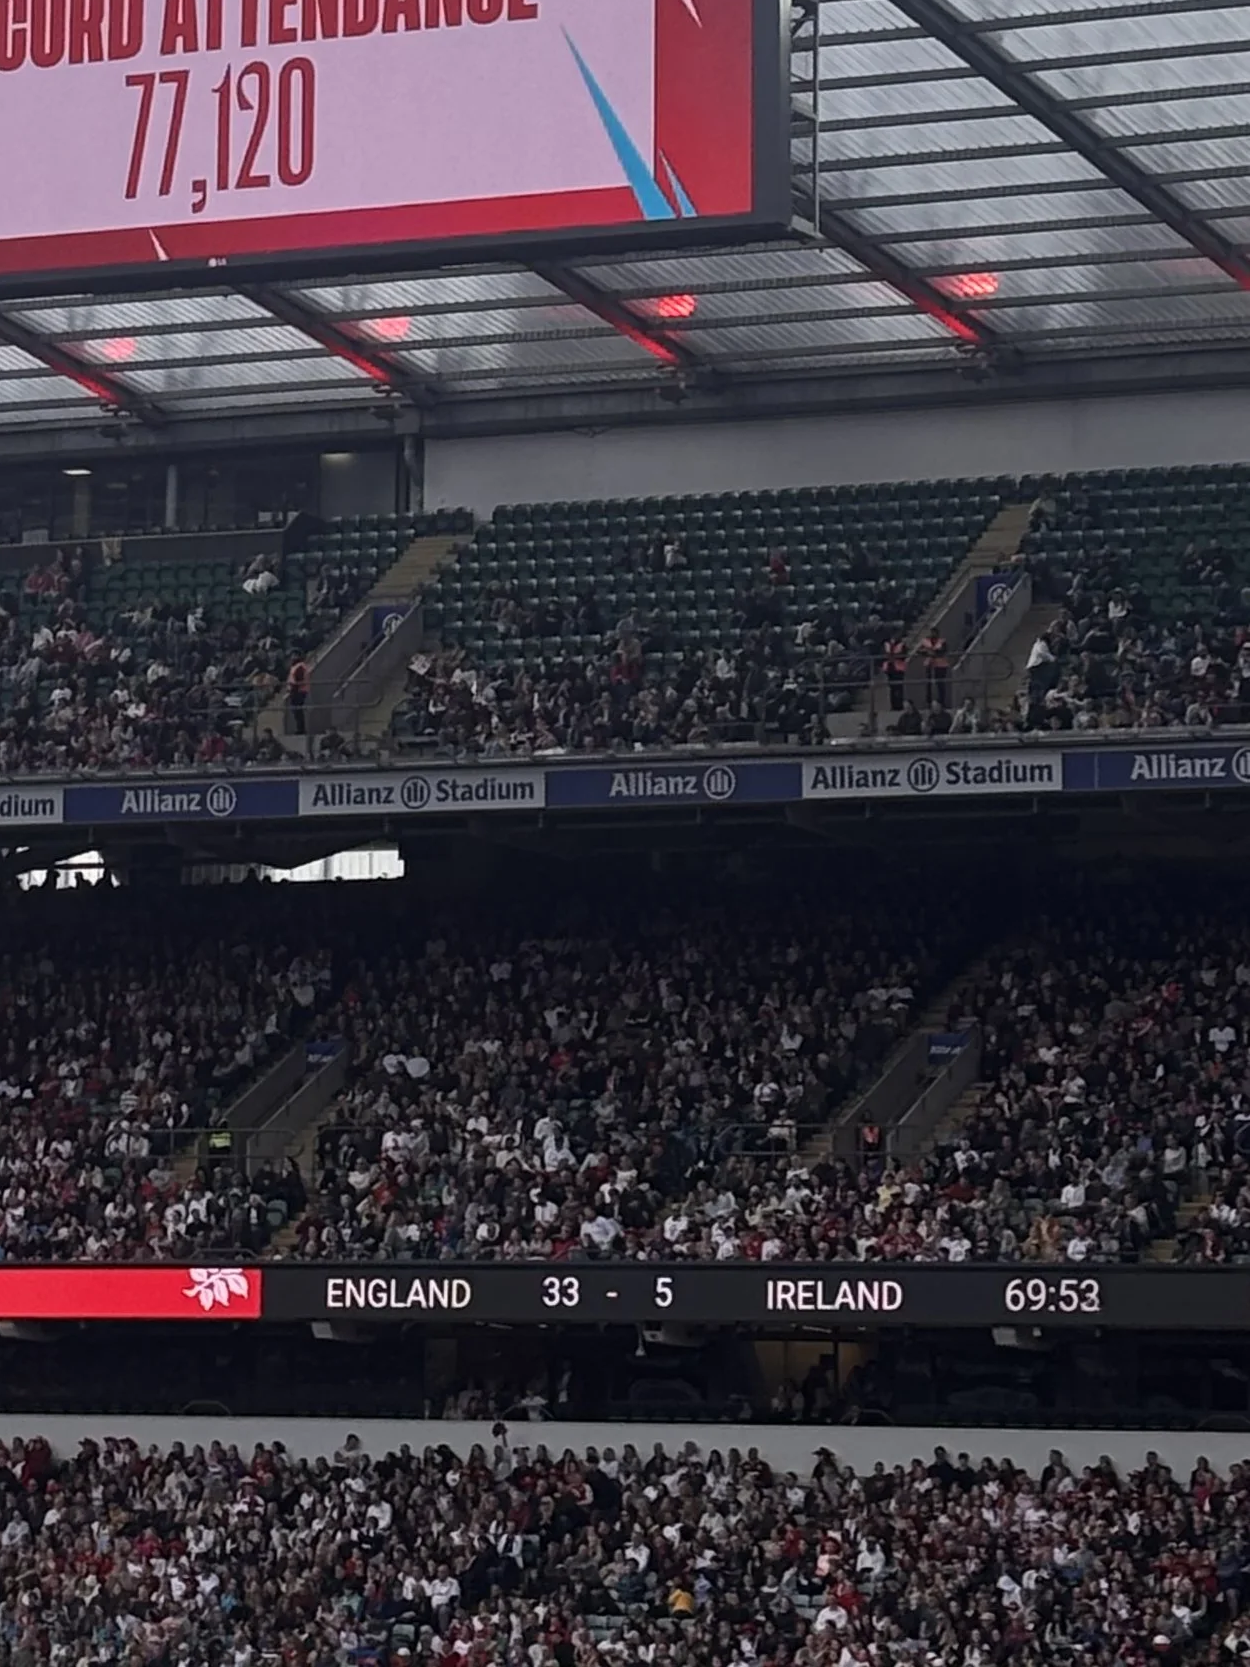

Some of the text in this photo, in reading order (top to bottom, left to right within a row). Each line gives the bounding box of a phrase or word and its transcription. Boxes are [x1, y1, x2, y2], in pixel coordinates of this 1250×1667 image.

[124, 56, 316, 213] 77,120
[810, 760, 1054, 790] Allianz Stadium
[1129, 754, 1227, 780] Allianz
[313, 777, 535, 807] Allianz Stadium
[609, 769, 698, 797] Allianz
[120, 787, 201, 814] Allianz
[326, 1279, 472, 1310] ENGLAND
[541, 1276, 580, 1308] 33
[654, 1277, 673, 1308] 5
[766, 1280, 903, 1311] IRELAND
[1005, 1278, 1100, 1312] 69:53
